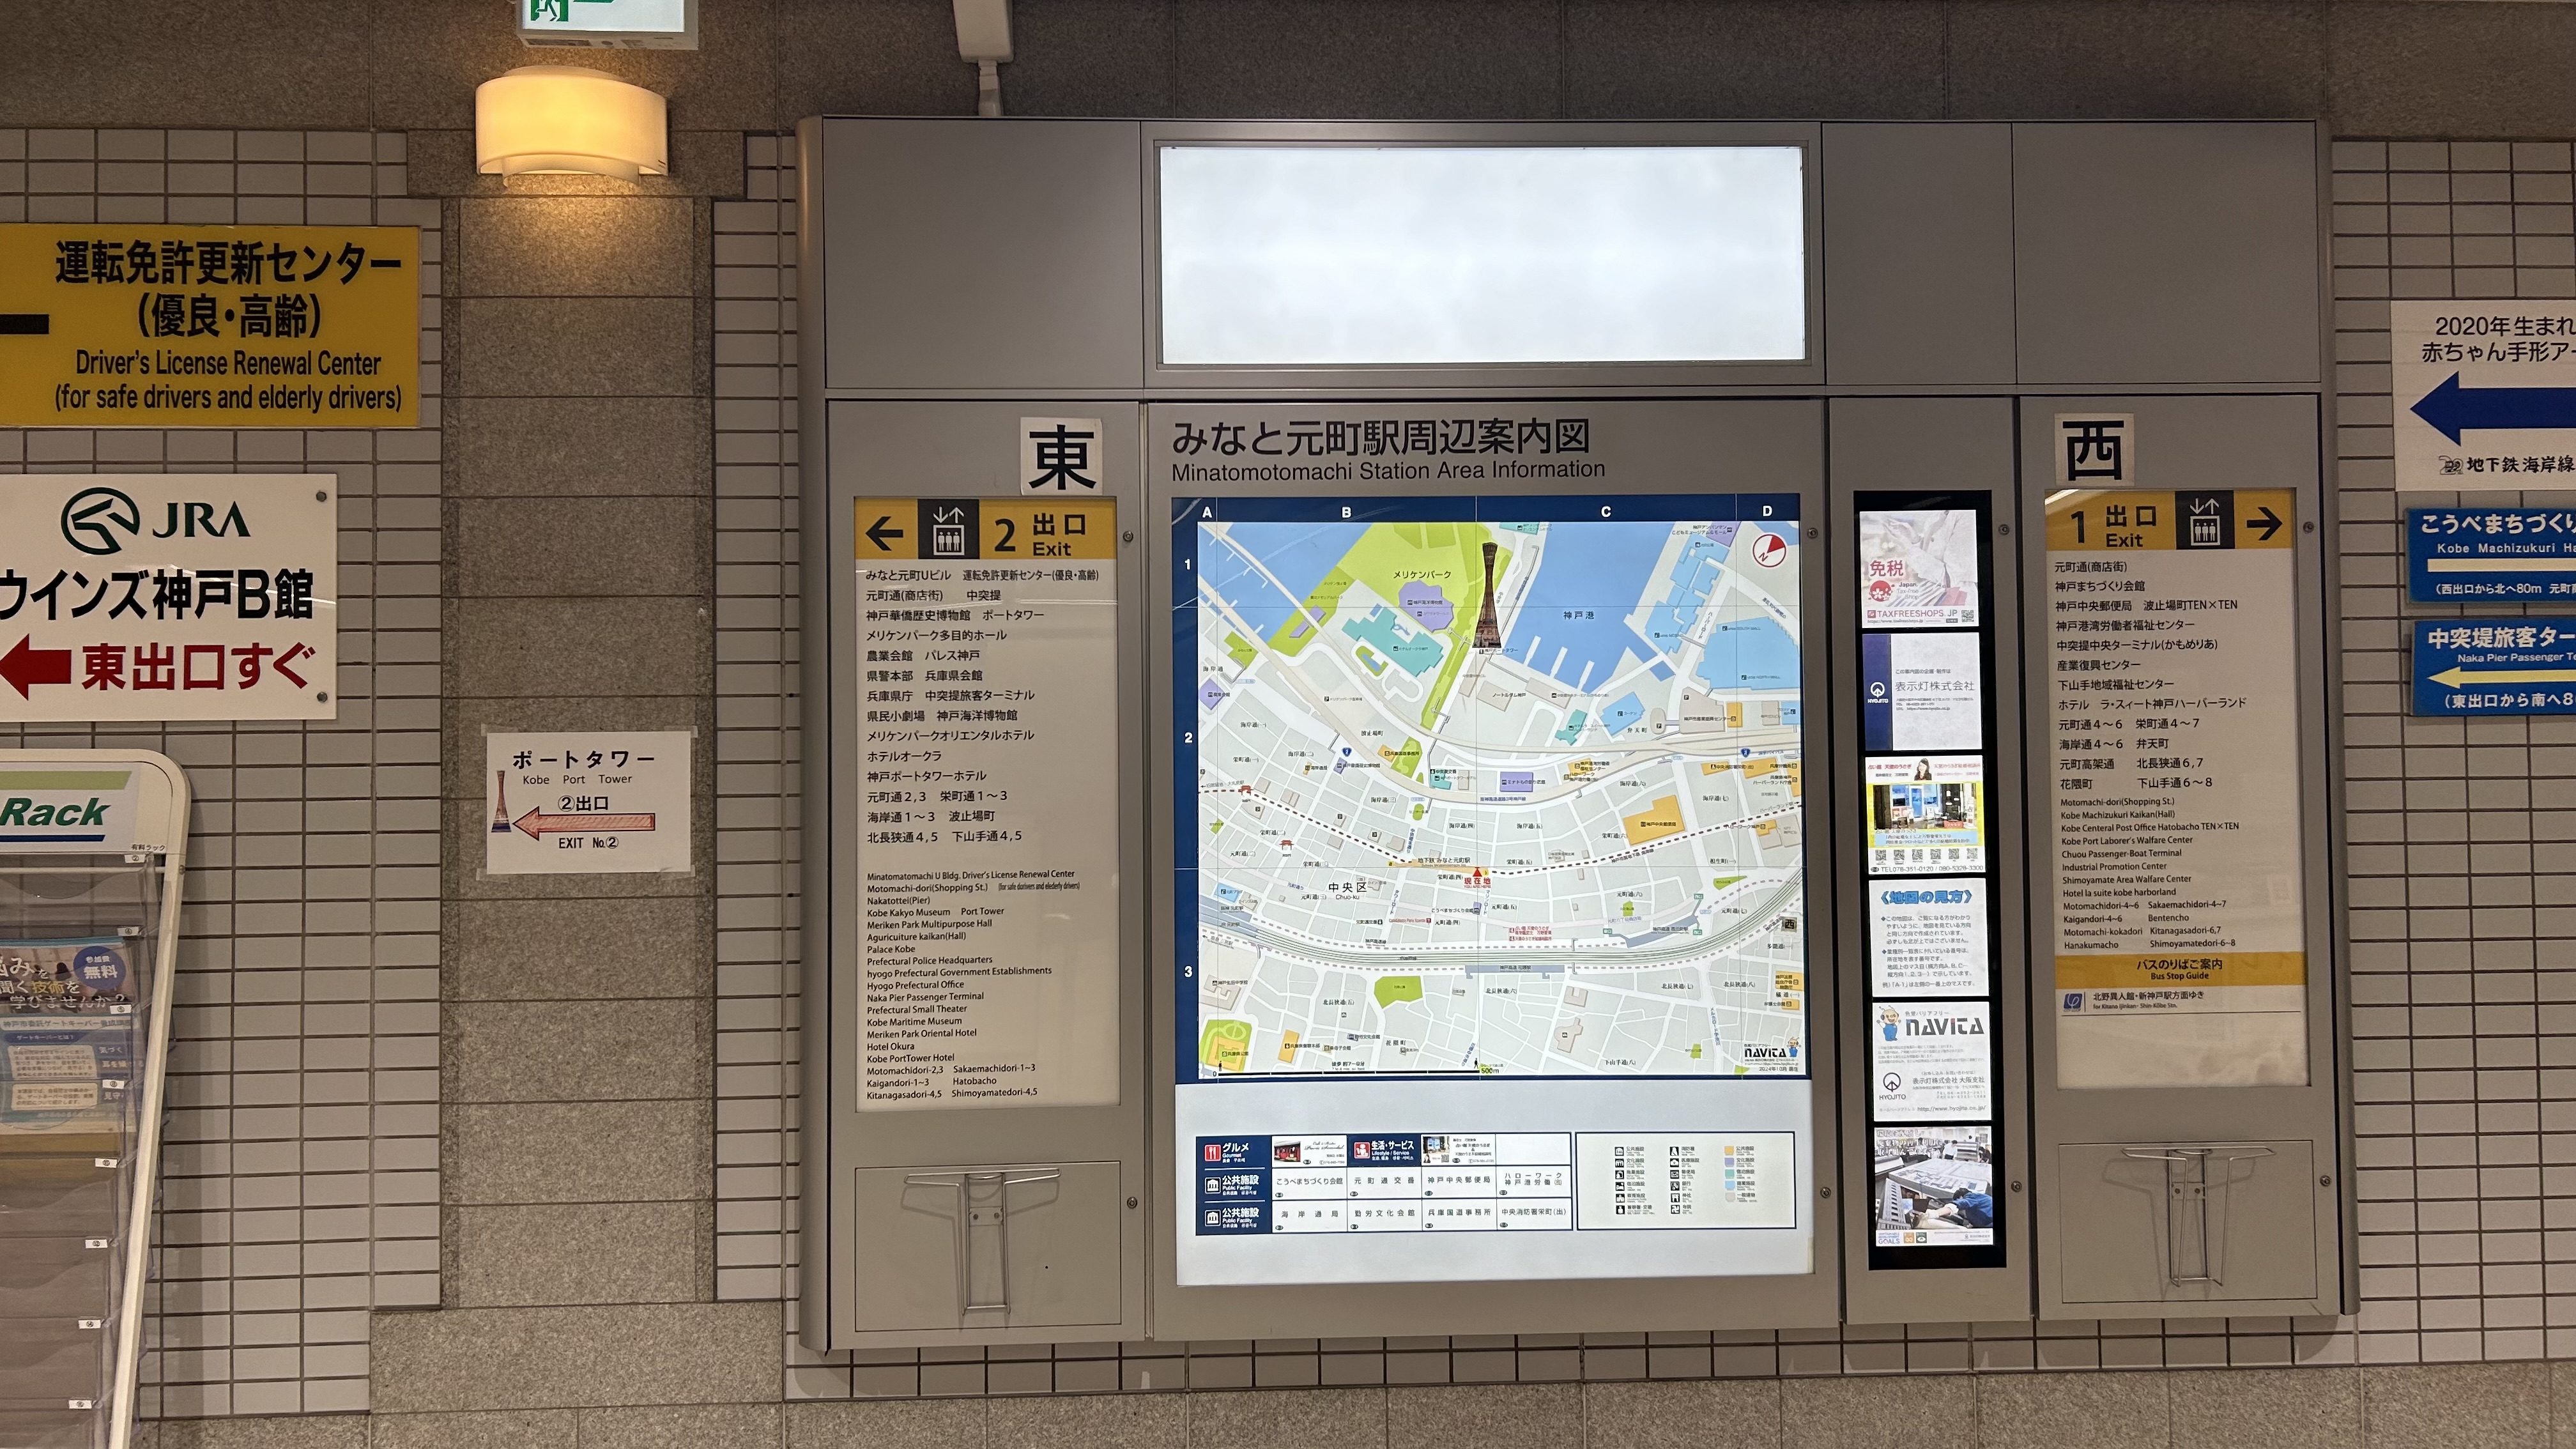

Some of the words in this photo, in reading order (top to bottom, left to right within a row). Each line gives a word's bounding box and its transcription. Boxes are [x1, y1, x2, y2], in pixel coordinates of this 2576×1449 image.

[56, 240, 401, 285] 運転免許更新センター
[139, 293, 320, 338] (優良・高齢)
[2436, 316, 2576, 337] 2020年生まれ
[2422, 341, 2576, 362] 赤ちゃん手形ア
[77, 349, 150, 374] Driver's
[157, 349, 227, 375] License
[234, 350, 311, 375] Renewal
[318, 350, 381, 375] Center
[56, 383, 91, 412] (for
[96, 383, 138, 408] safe
[144, 384, 211, 408] drivers
[218, 384, 252, 408] and
[259, 384, 323, 414] elderly
[329, 385, 401, 413] drivers)
[1173, 417, 1589, 456] みなと元町駅周辺案内図
[2063, 420, 2124, 481] 西
[1029, 424, 1096, 490] 東
[2467, 455, 2575, 473] 地下鉄海岸線
[1173, 463, 1351, 481] Minatomotomachi
[1360, 462, 1429, 479] Station
[1438, 461, 1485, 479] Area
[1492, 460, 1604, 477] Information
[1202, 507, 1212, 518] A
[1342, 506, 1351, 518] B
[1602, 506, 1611, 518] C
[1763, 506, 1772, 516] D
[153, 501, 250, 538] JRA
[2071, 511, 2084, 543] 1
[2106, 505, 2156, 527] 出口
[995, 519, 1015, 551] 2
[1033, 513, 1085, 535] 出口
[2106, 533, 2143, 547] Exit
[1033, 542, 1071, 556] Exit
[2438, 544, 2469, 553] Kobe
[2479, 543, 2555, 553] Machizukuri
[1184, 559, 1190, 570] 1
[1870, 560, 1903, 577] 免税
[2055, 561, 2127, 572] 元町通(商店街)
[865, 570, 951, 581] みなと元町Uビル
[1393, 571, 1452, 579] メリケンパーク
[2055, 580, 2145, 592] 神戸まちづくり会館
[866, 590, 942, 601] 元町通(商店街)
[2055, 601, 2131, 612] 神戸中央郵便局
[866, 610, 970, 621] 神戸華僑歴史博物館
[983, 610, 1044, 620] ポートタワー
[1563, 611, 1595, 620] 神戸港
[2056, 620, 2195, 632] 神戸港湾労働者福祉センター
[867, 630, 1007, 641] メリケンパーク多目的ホール
[867, 650, 913, 661] 農業会館
[925, 650, 980, 661] パレス神戸
[2511, 654, 2564, 662] Passenger
[82, 642, 316, 691] 東出口すぐ
[2057, 660, 2140, 671] 産業復興センター
[868, 670, 913, 682] 県警本部
[925, 670, 983, 681] 兵庫県会館
[1895, 681, 1975, 691] 表示灯株式会社
[2058, 679, 2174, 691] 下山手地域福祉センター
[867, 691, 913, 702] 兵庫県庁
[2058, 700, 2089, 710] ホテル
[868, 710, 924, 722] 県民小劇場
[937, 710, 1017, 721] 神戸海洋博物館
[868, 730, 1034, 741] メリケンパークオリエンタルホテル
[1184, 732, 1193, 743] 2
[2136, 738, 2169, 749] 弁天町
[513, 751, 654, 769] ポートタワー
[868, 751, 941, 762] ホテルオークラ
[2060, 758, 2114, 770] 元町高架通
[523, 775, 549, 784] Kobe
[564, 775, 585, 784] Port
[599, 775, 632, 783] Tower
[868, 770, 986, 782] 神戸ポートタワーホテル
[2060, 779, 2093, 790] 花隈町
[0, 798, 111, 825] Rack
[949, 811, 995, 822] 波止場町
[559, 838, 584, 848] EXIT
[1464, 877, 1491, 885] 現在地
[1329, 882, 1368, 893] 中央区
[890, 908, 914, 918] Kakyo
[2137, 958, 2222, 970] バスのりばご案内
[84, 965, 118, 979] 無料
[1184, 966, 1193, 977] 3
[2166, 972, 2184, 981] Stop
[1223, 1142, 1248, 1151] グルメ
[1372, 1141, 1414, 1150] 生活・サービス
[1222, 1176, 1259, 1185] 公共施設
[1222, 1208, 1259, 1218] 公共施設
